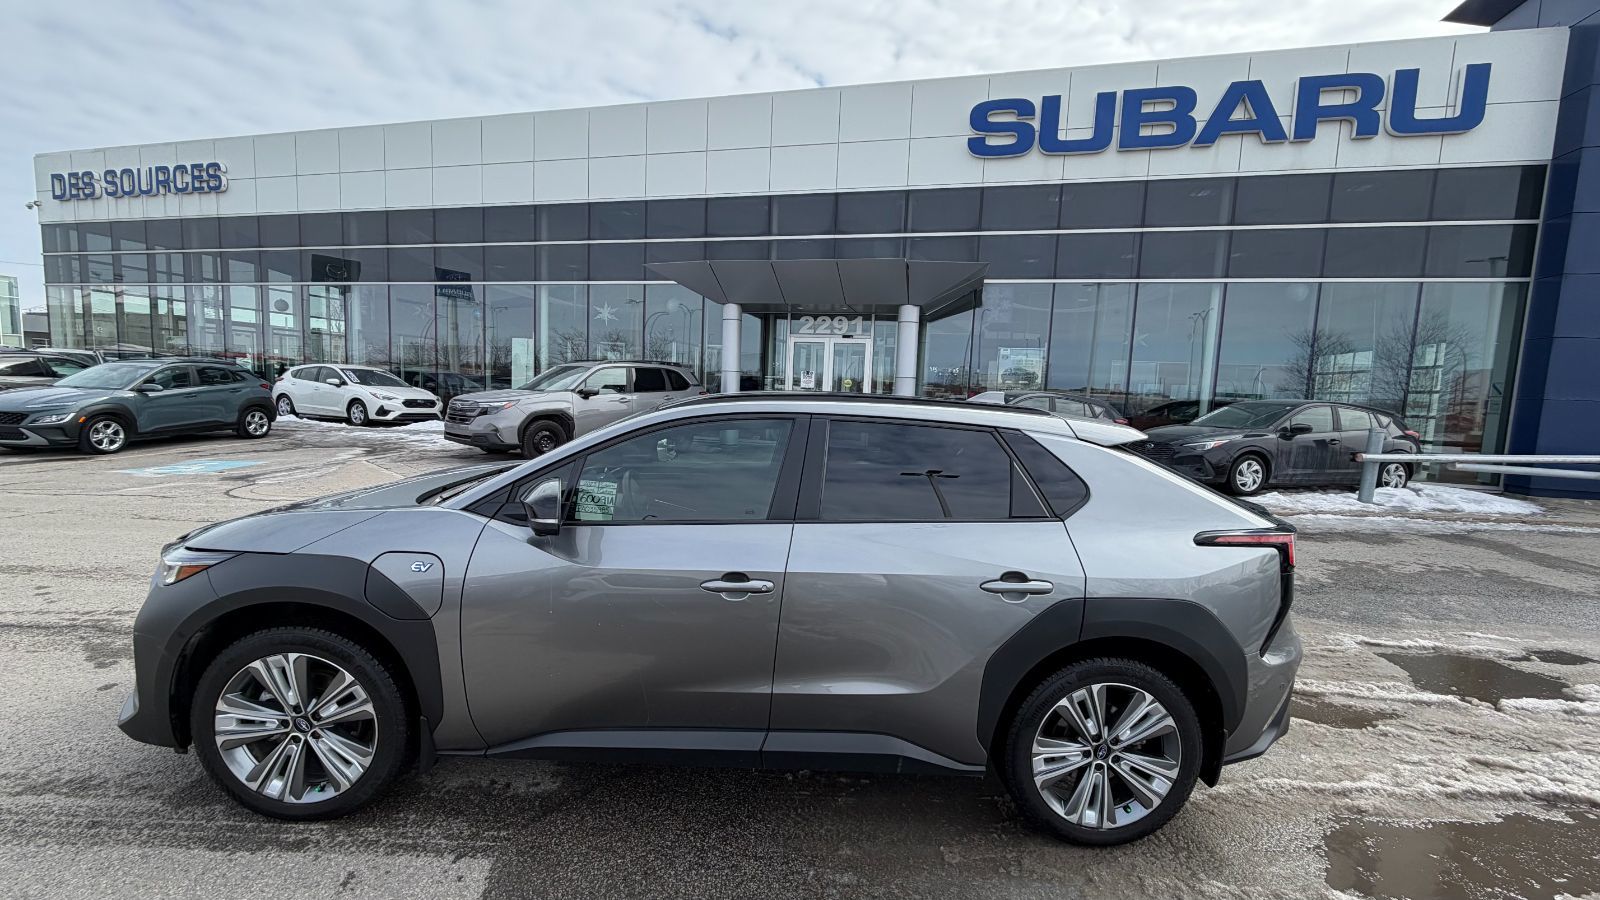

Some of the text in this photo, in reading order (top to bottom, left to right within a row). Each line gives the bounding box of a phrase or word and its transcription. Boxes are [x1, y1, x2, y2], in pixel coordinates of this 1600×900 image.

[968, 63, 1492, 158] SUBARU
[51, 162, 226, 201] DES SOURCES
[799, 316, 863, 335] 2291
[411, 561, 433, 573] EV
